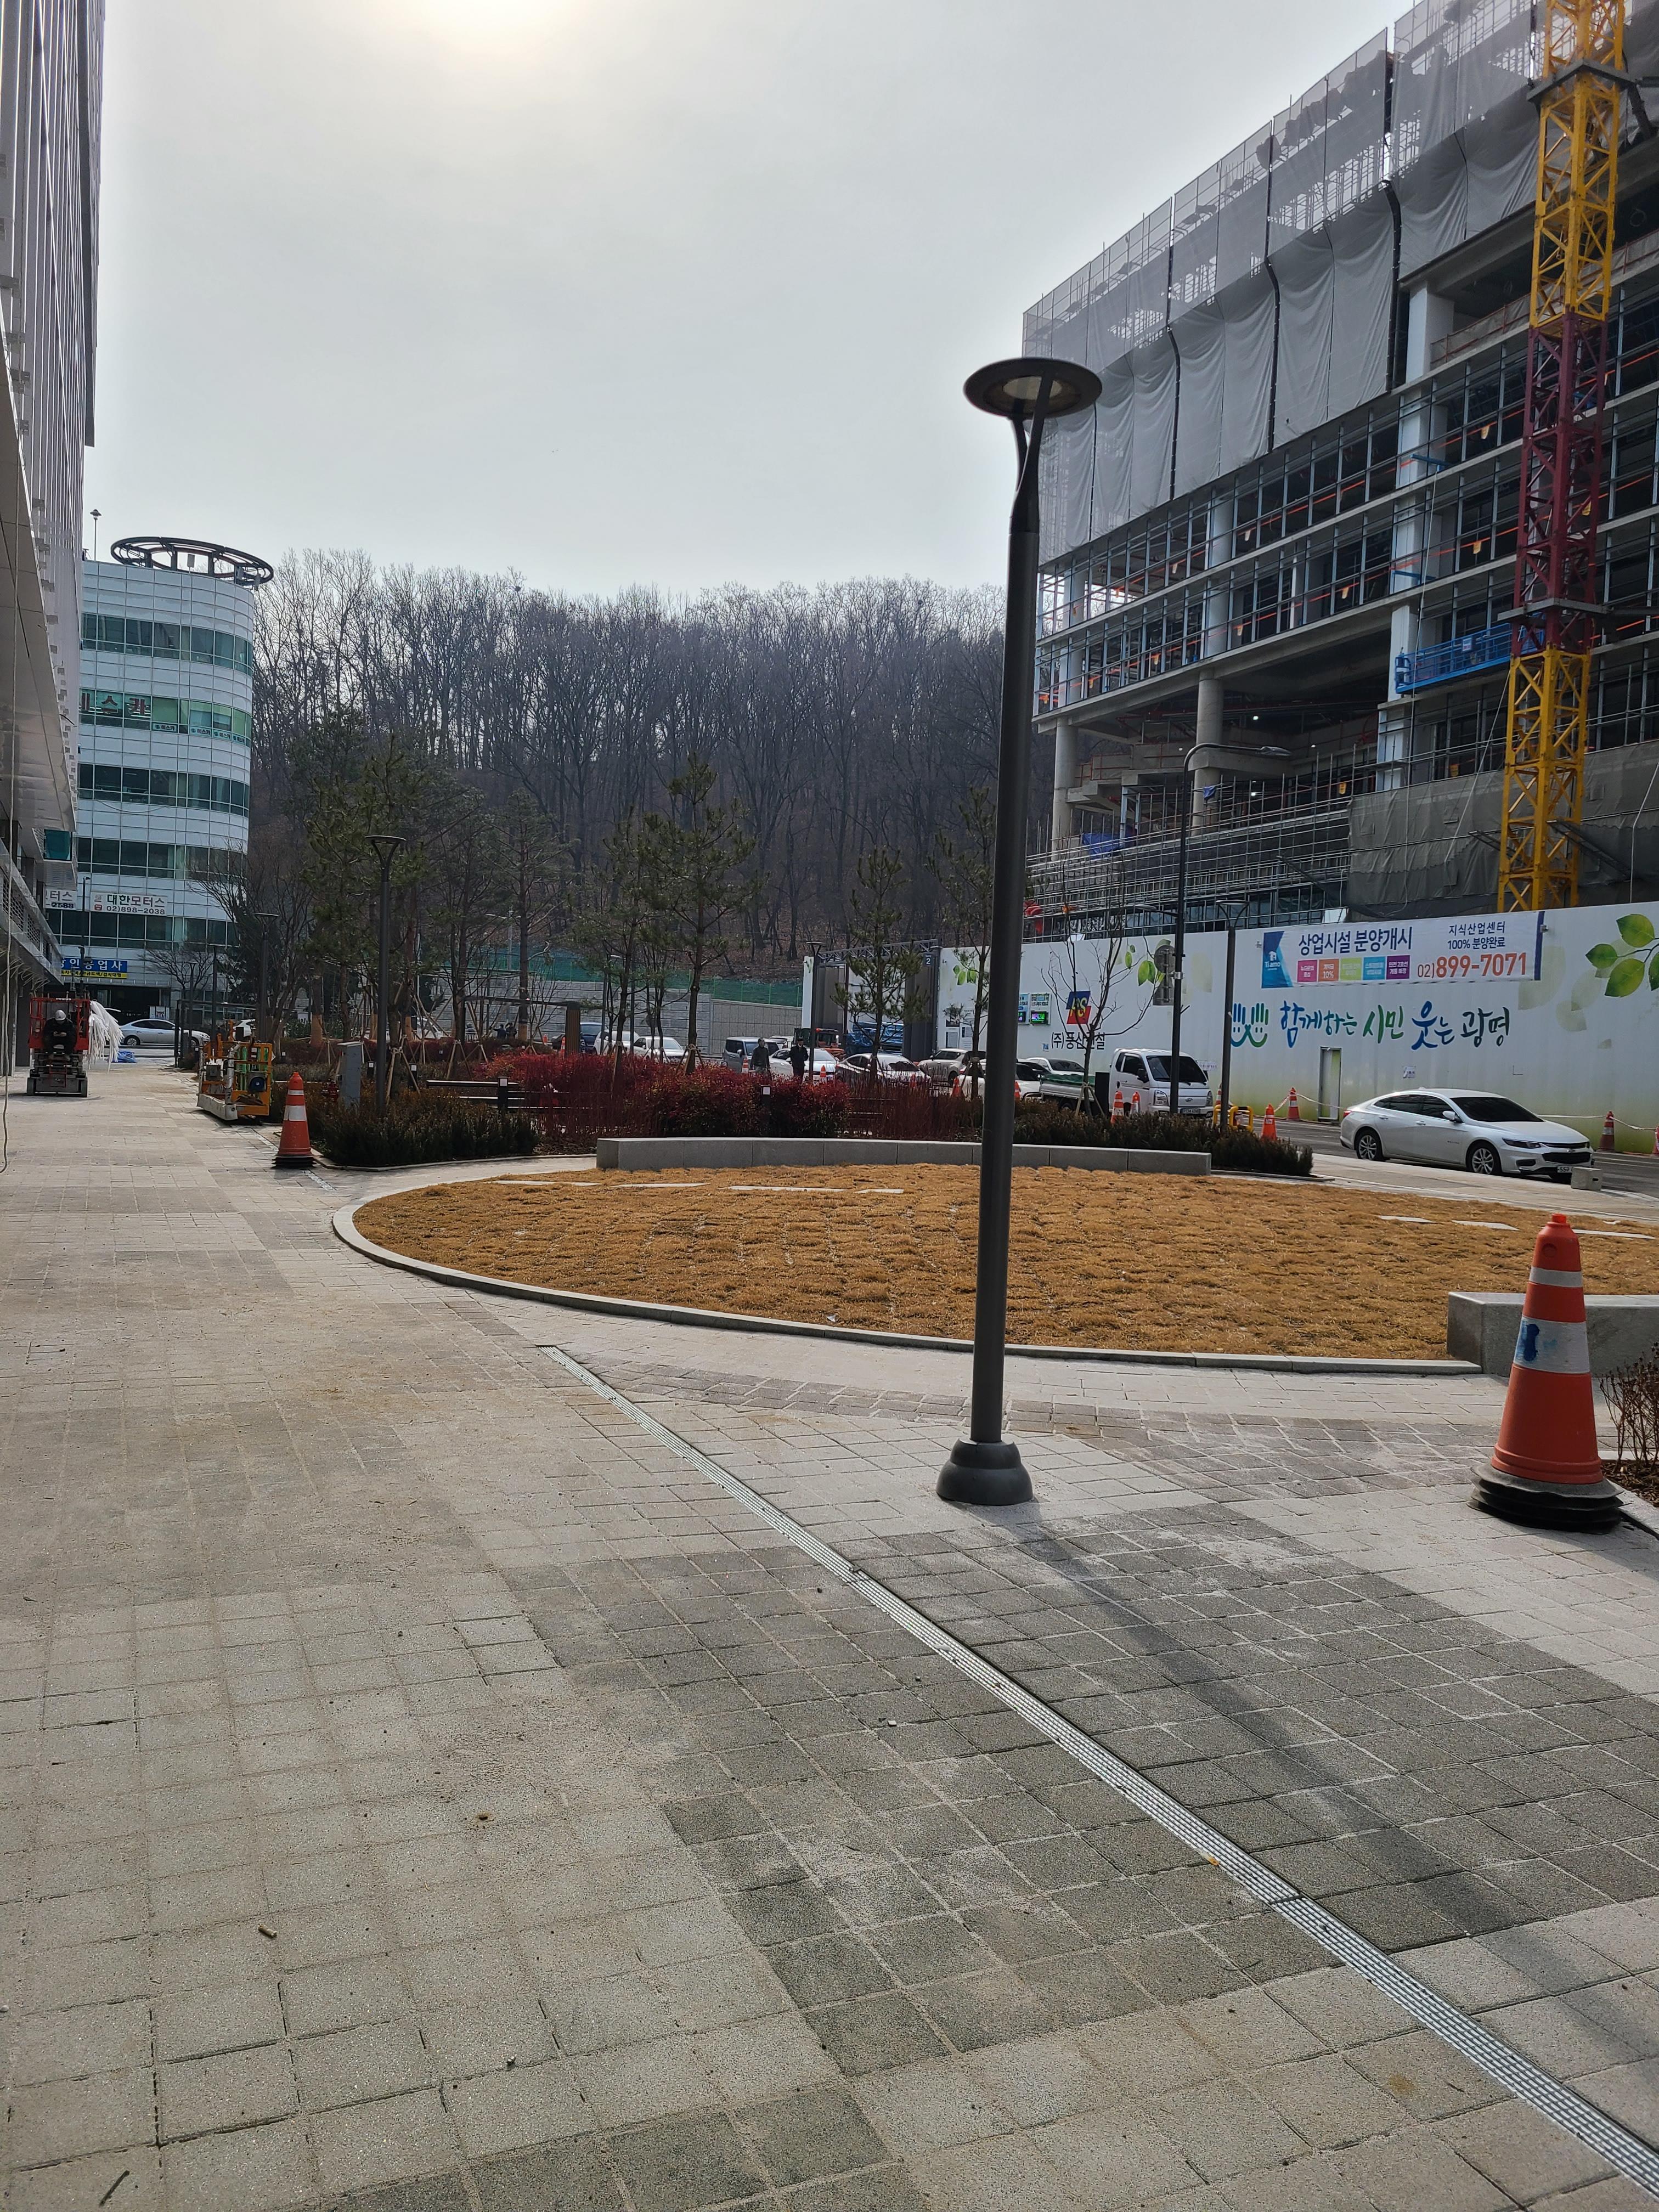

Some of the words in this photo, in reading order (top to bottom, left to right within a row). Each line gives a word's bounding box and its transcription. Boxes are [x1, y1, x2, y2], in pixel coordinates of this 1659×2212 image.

[46, 890, 72, 901] 터스
[107, 894, 165, 907] 대한모터스
[106, 905, 165, 915] 02)898-2038
[1448, 921, 1506, 936] 지식산업센터
[1298, 931, 1351, 956] 상업시설
[1354, 926, 1413, 952] 분양개시
[1447, 939, 1471, 950] 100%
[1472, 936, 1506, 950] 분양완료
[1417, 952, 1526, 979] 02)899-7071
[1323, 970, 1334, 979] 10%
[1280, 1000, 1358, 1048] 함께하는
[1362, 1004, 1404, 1044] 시민
[1411, 1000, 1455, 1051] 웃는
[1460, 1007, 1510, 1047] 광명
